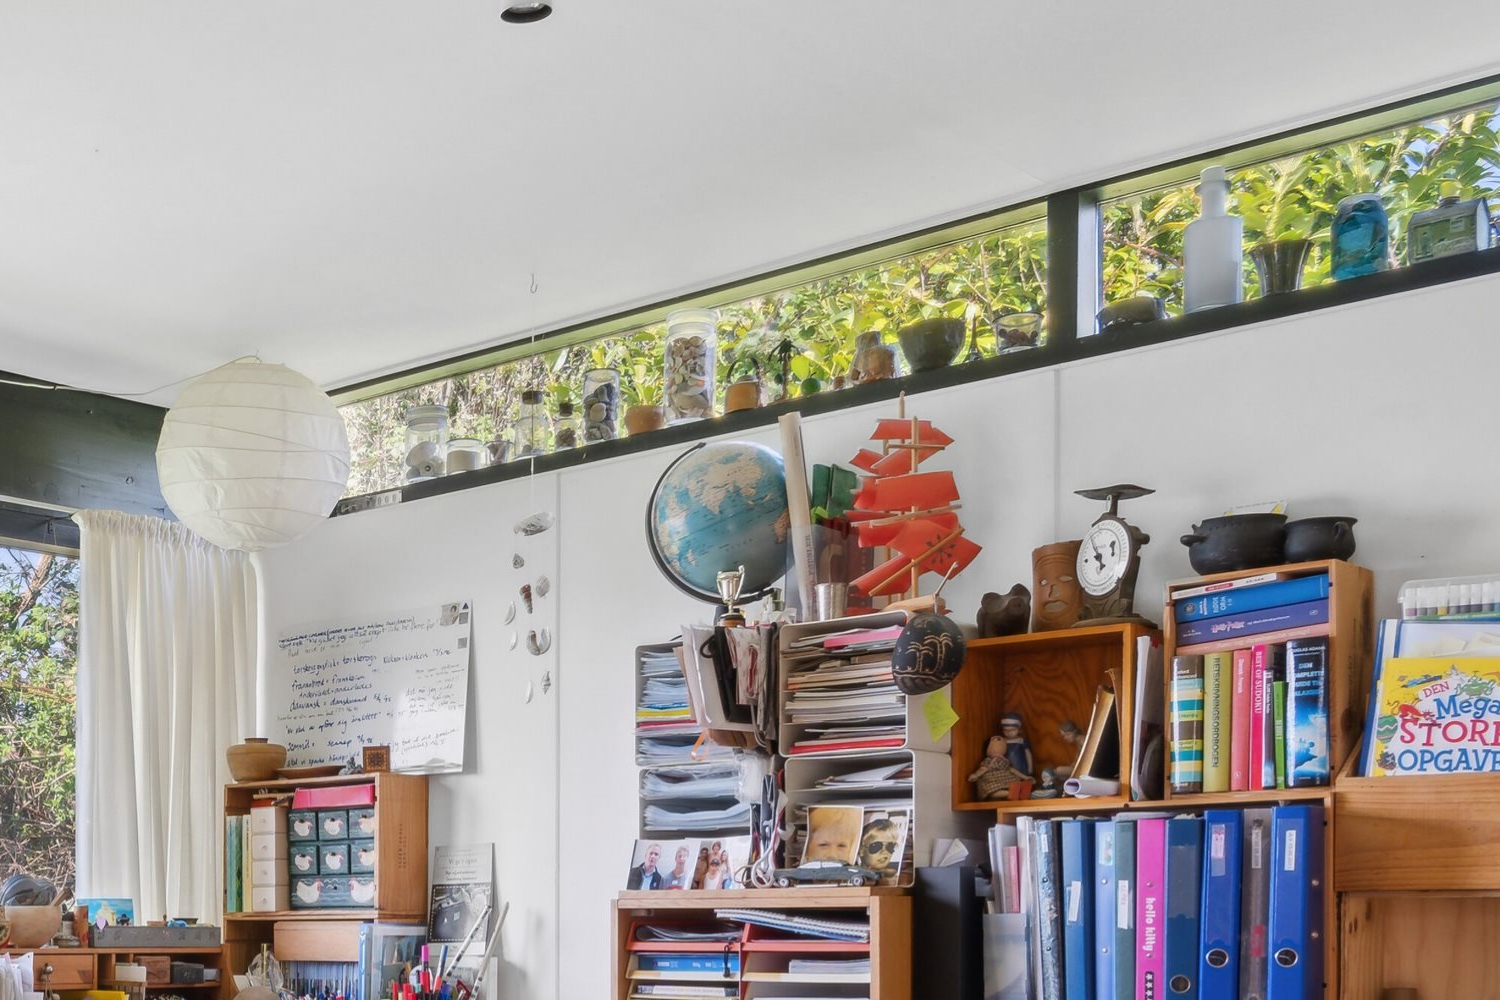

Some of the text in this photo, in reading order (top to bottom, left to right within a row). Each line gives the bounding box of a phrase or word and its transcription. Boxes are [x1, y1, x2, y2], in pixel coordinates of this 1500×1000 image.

[1255, 651, 1263, 668] BEST
[1254, 680, 1263, 714] SUDOKU
[1423, 682, 1450, 698] DEN
[1211, 657, 1221, 768] RETSKRIVNINGSORDBOGEN
[1433, 695, 1500, 720] Mega
[1142, 897, 1156, 951] hello kitty
